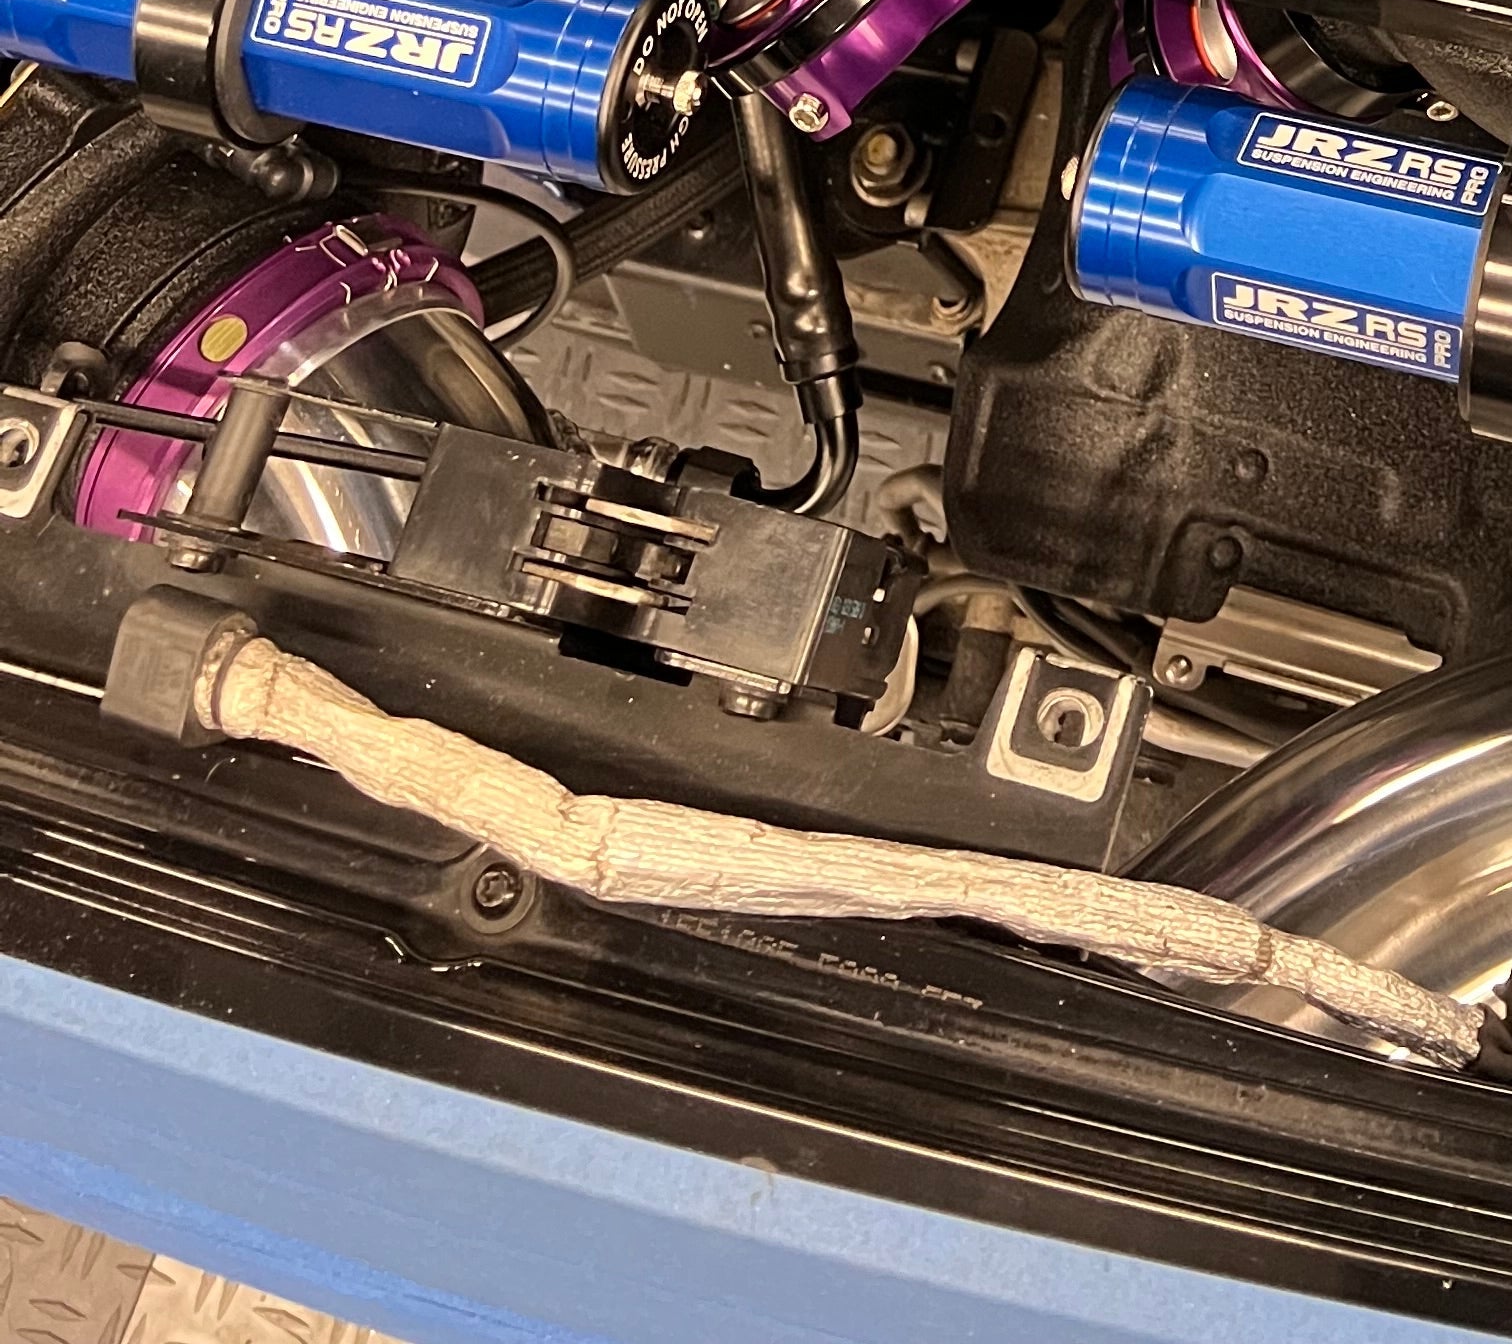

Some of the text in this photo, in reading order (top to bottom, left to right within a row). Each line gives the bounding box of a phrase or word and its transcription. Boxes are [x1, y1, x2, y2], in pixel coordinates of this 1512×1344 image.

[283, 8, 475, 74] JRZ RS
[390, 8, 479, 39] SUSPENSION
[633, 35, 654, 77] DO
[621, 132, 667, 180] PRESSURE
[1250, 148, 1456, 202] SUSPENSION ENGINEERING
[1257, 123, 1467, 186] JRZ RS
[1460, 165, 1490, 206] PRO
[1223, 284, 1427, 349] JRZ RS
[1223, 308, 1428, 363] SUSPENSION ENGINEERING
[1433, 329, 1452, 369] PRO
